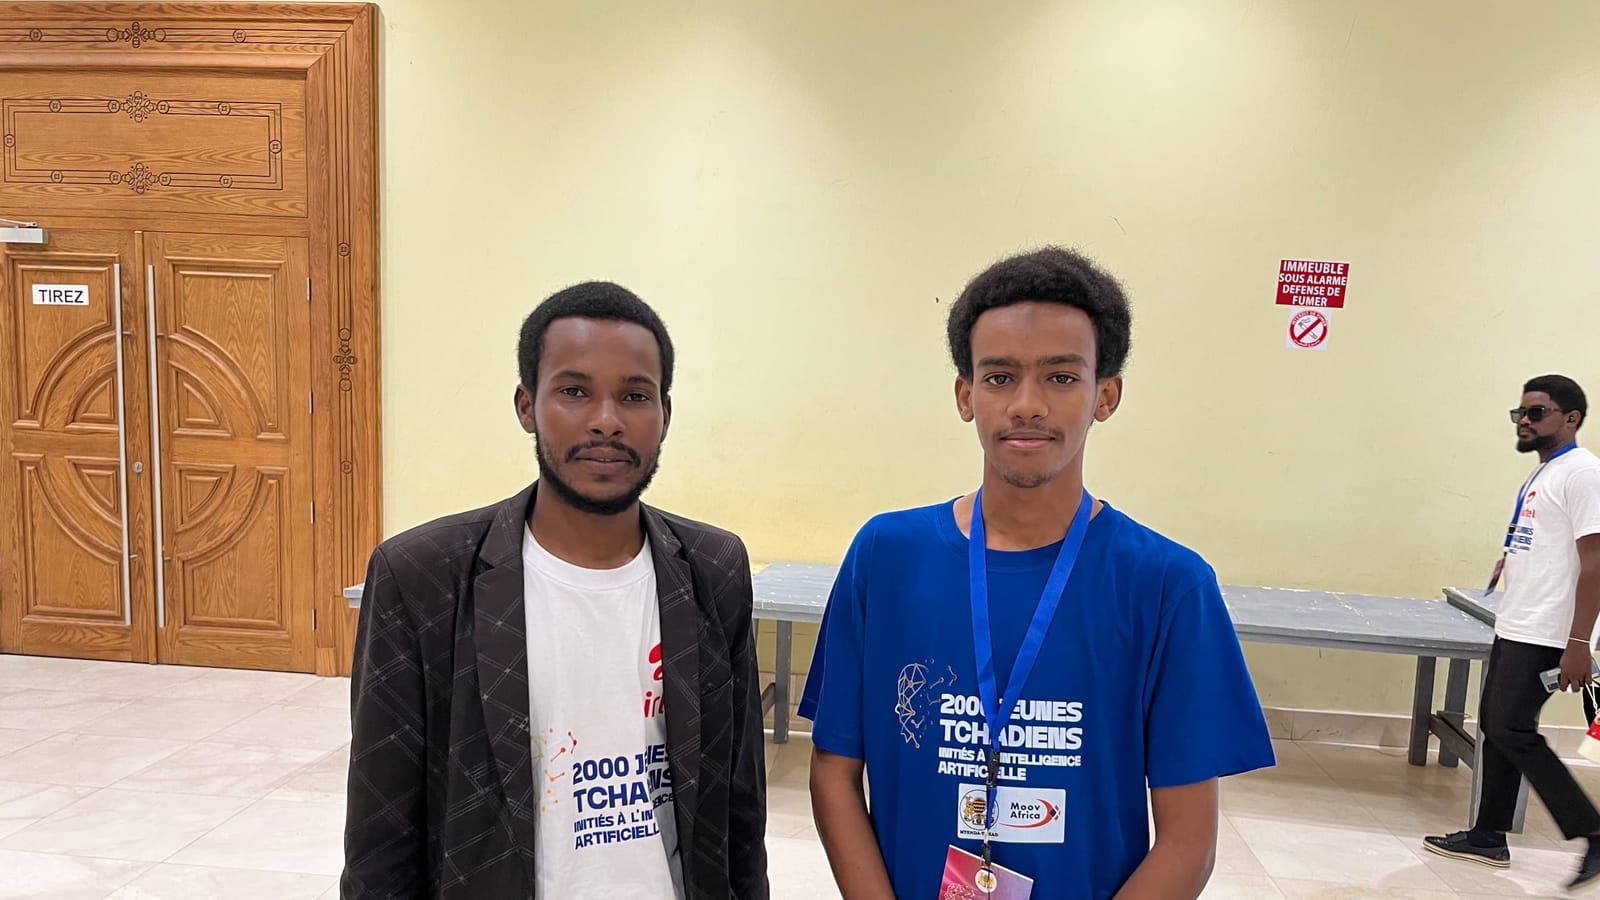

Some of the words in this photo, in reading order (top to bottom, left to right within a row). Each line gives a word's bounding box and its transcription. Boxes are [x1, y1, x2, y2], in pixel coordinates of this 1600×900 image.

[1283, 261, 1344, 274] IMMEUBLE
[1279, 273, 1305, 283] SOUS
[1306, 275, 1347, 286] ALARME
[38, 289, 84, 303] TIREZ
[1282, 284, 1326, 296] DEFENSE
[1327, 287, 1340, 297] DE
[1292, 295, 1328, 307] FUMER
[999, 698, 1083, 722] EUNES
[938, 746, 975, 761] INITIÉS
[976, 747, 986, 762] À
[1000, 751, 1081, 767] INTELLIGENCE
[572, 755, 630, 785] 2000
[938, 760, 1027, 781] ARTIFICELLE
[1010, 802, 1041, 811] Moov
[574, 814, 614, 833] INITIÉS
[617, 811, 627, 826] À
[1010, 811, 1041, 820] Africa
[575, 822, 660, 850] ARTIFICIELL
